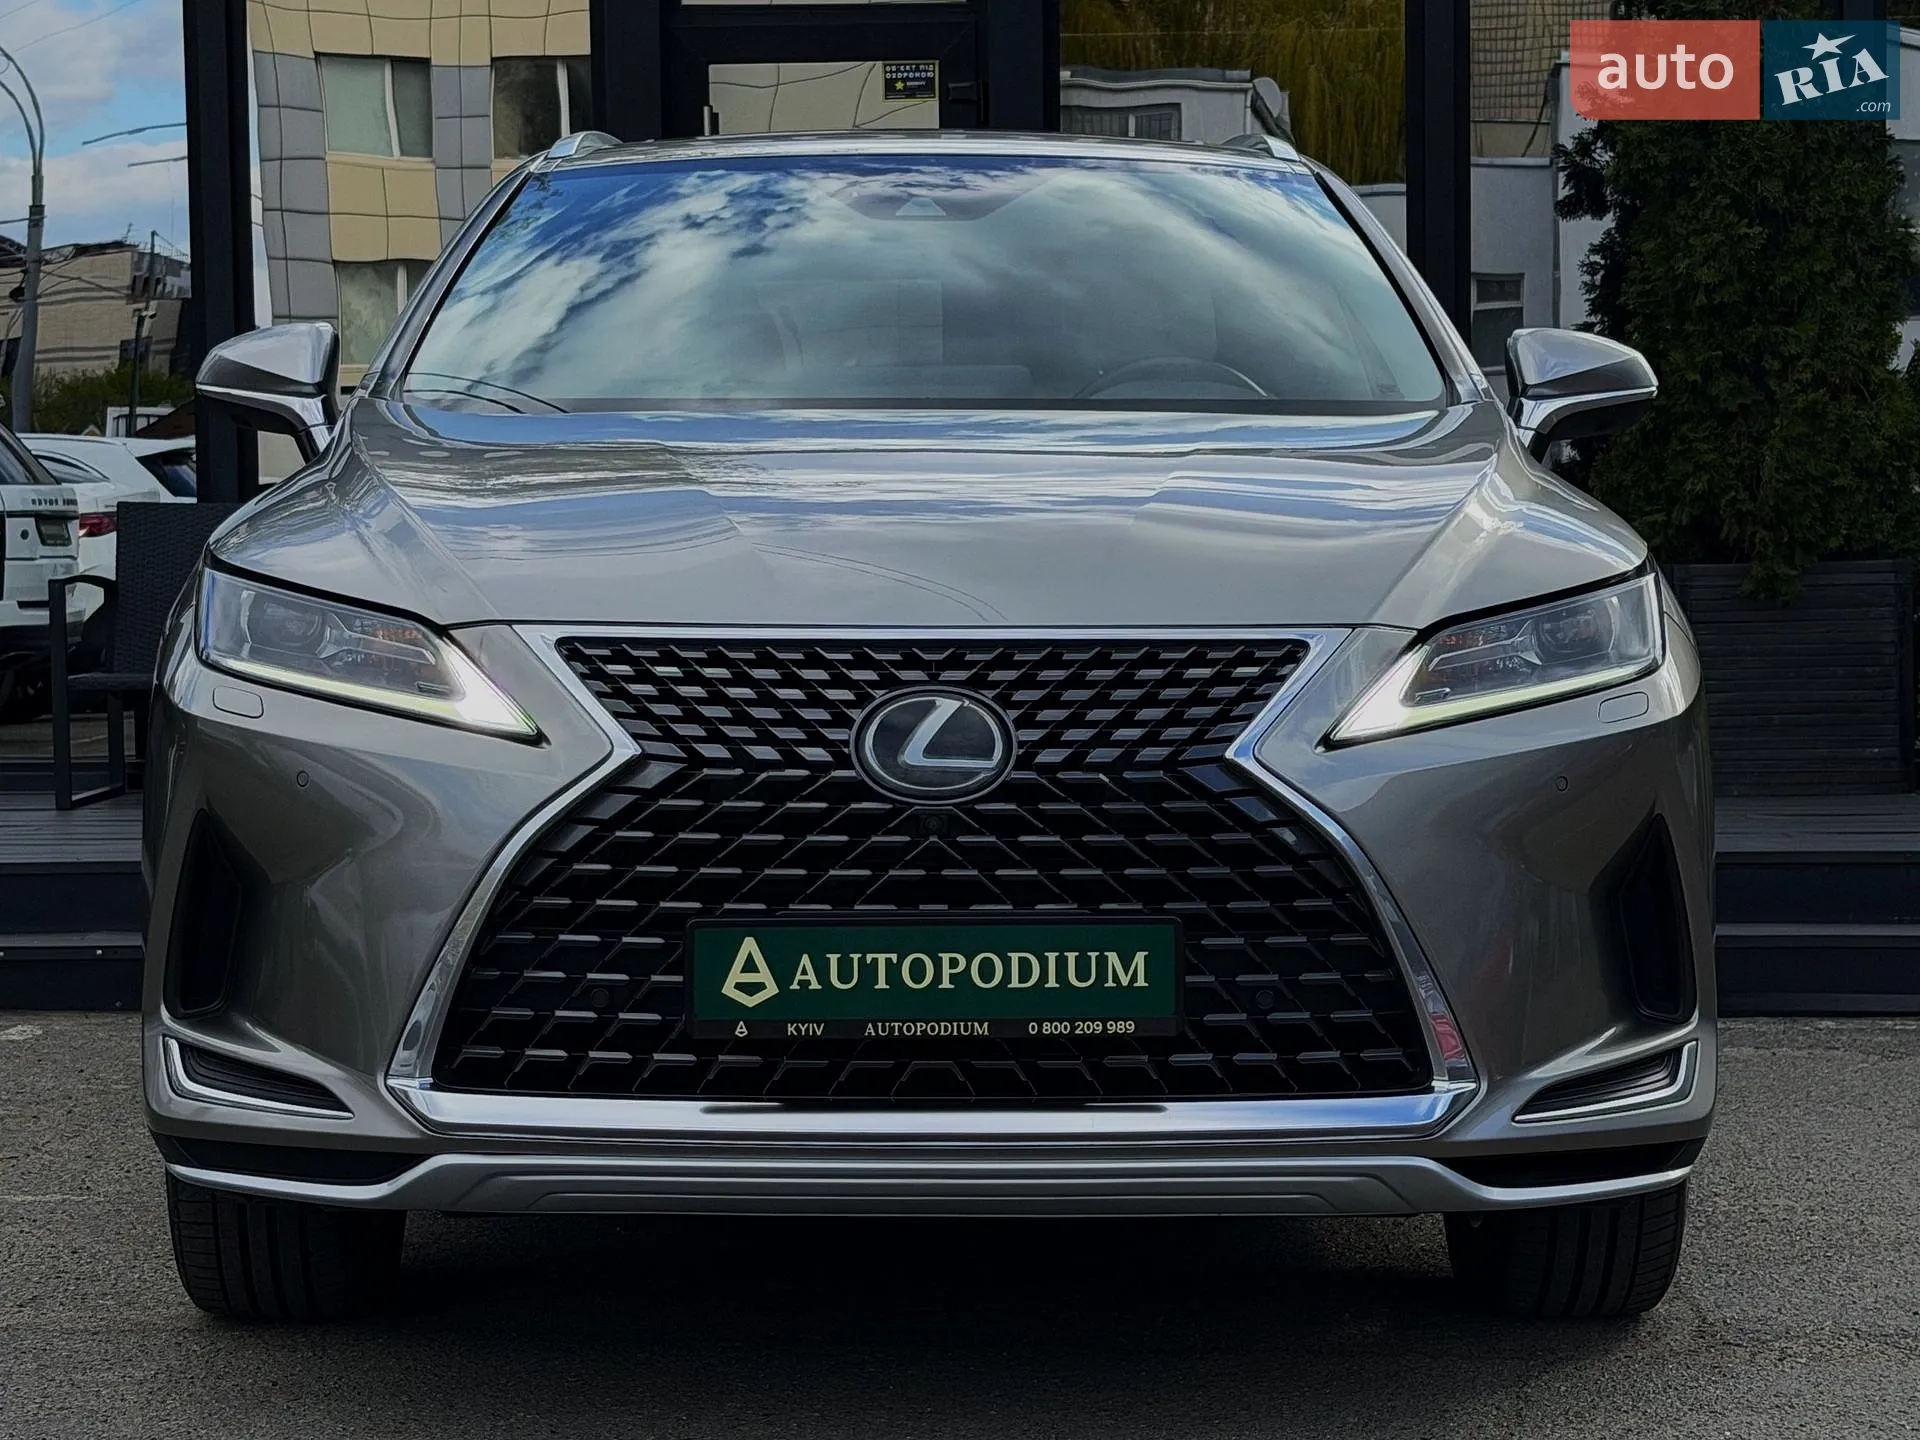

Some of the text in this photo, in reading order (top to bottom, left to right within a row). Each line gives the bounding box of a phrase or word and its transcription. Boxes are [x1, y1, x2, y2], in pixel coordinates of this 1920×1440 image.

[789, 951, 1149, 989] AUTOPODIUM
[787, 1023, 825, 1036] KYIV
[864, 1021, 989, 1036] AUTOPODIUM
[1028, 1022, 1038, 1035] 0
[1042, 1021, 1070, 1034] 800
[1074, 1021, 1103, 1034] 209
[1106, 1020, 1135, 1034] 989
